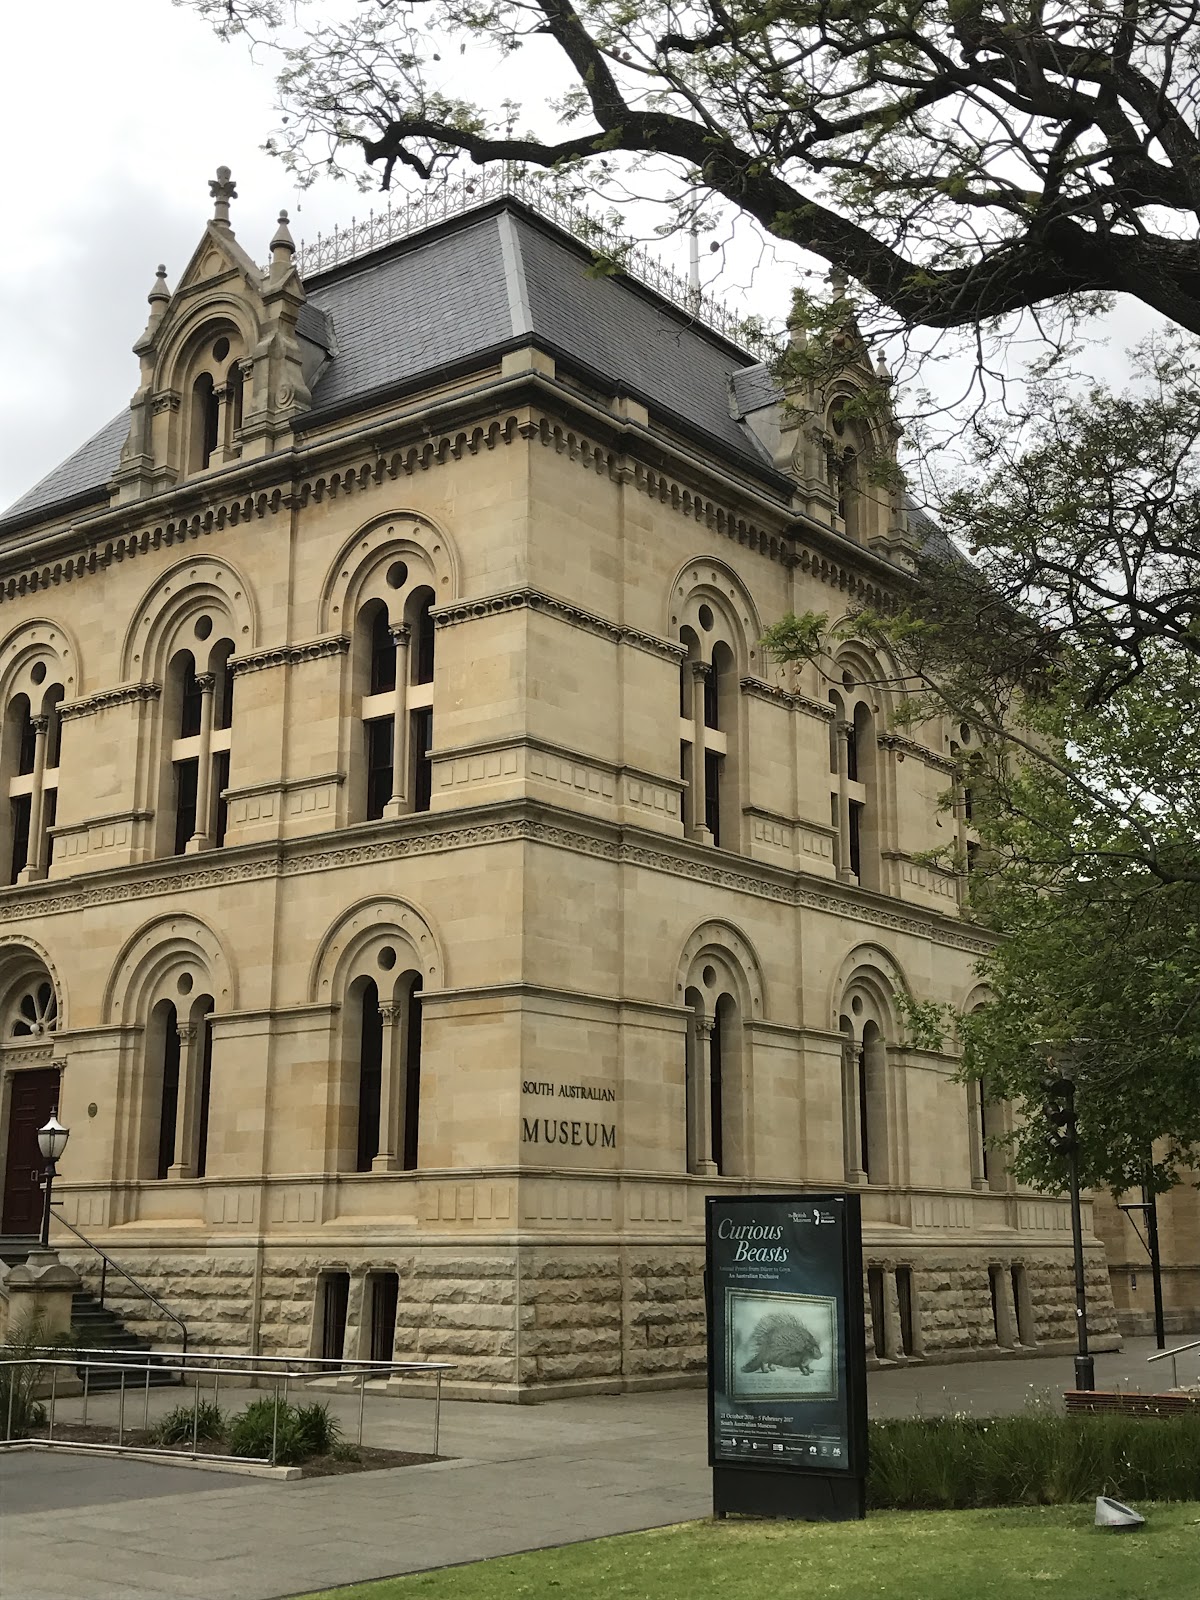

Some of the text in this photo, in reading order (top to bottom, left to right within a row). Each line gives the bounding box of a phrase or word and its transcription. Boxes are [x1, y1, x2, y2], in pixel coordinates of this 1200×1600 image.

[522, 1081, 616, 1102] SOUTH AUSTRALIAN
[522, 1117, 616, 1149] MUSEUM
[718, 1218, 784, 1240] Curious
[733, 1240, 790, 1263] Beasts
[762, 1415, 783, 1423] February
